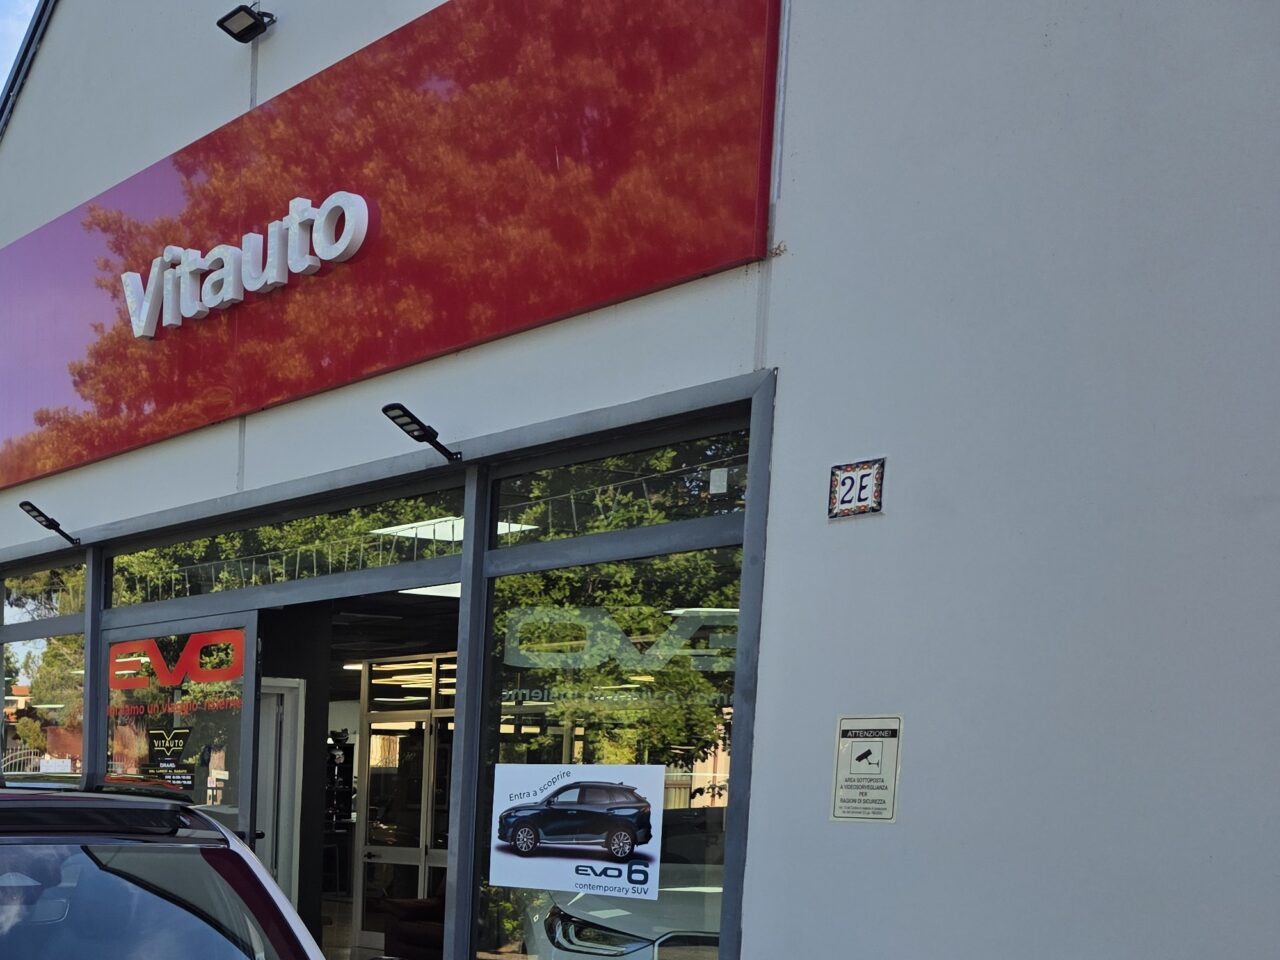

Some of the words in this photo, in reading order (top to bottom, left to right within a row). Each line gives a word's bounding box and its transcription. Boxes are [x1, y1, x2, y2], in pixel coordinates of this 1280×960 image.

[121, 191, 370, 340] Vitauto
[840, 473, 872, 505] 2E
[109, 629, 246, 690] EVO
[154, 739, 184, 747] VITAUTO
[847, 730, 892, 738] ATTENZIONE!
[509, 791, 531, 802] Entra
[539, 770, 571, 794] scoprire
[575, 865, 622, 878] EVO
[627, 860, 650, 885] 6
[575, 882, 629, 895] contemporary
[631, 886, 649, 895] SUV
